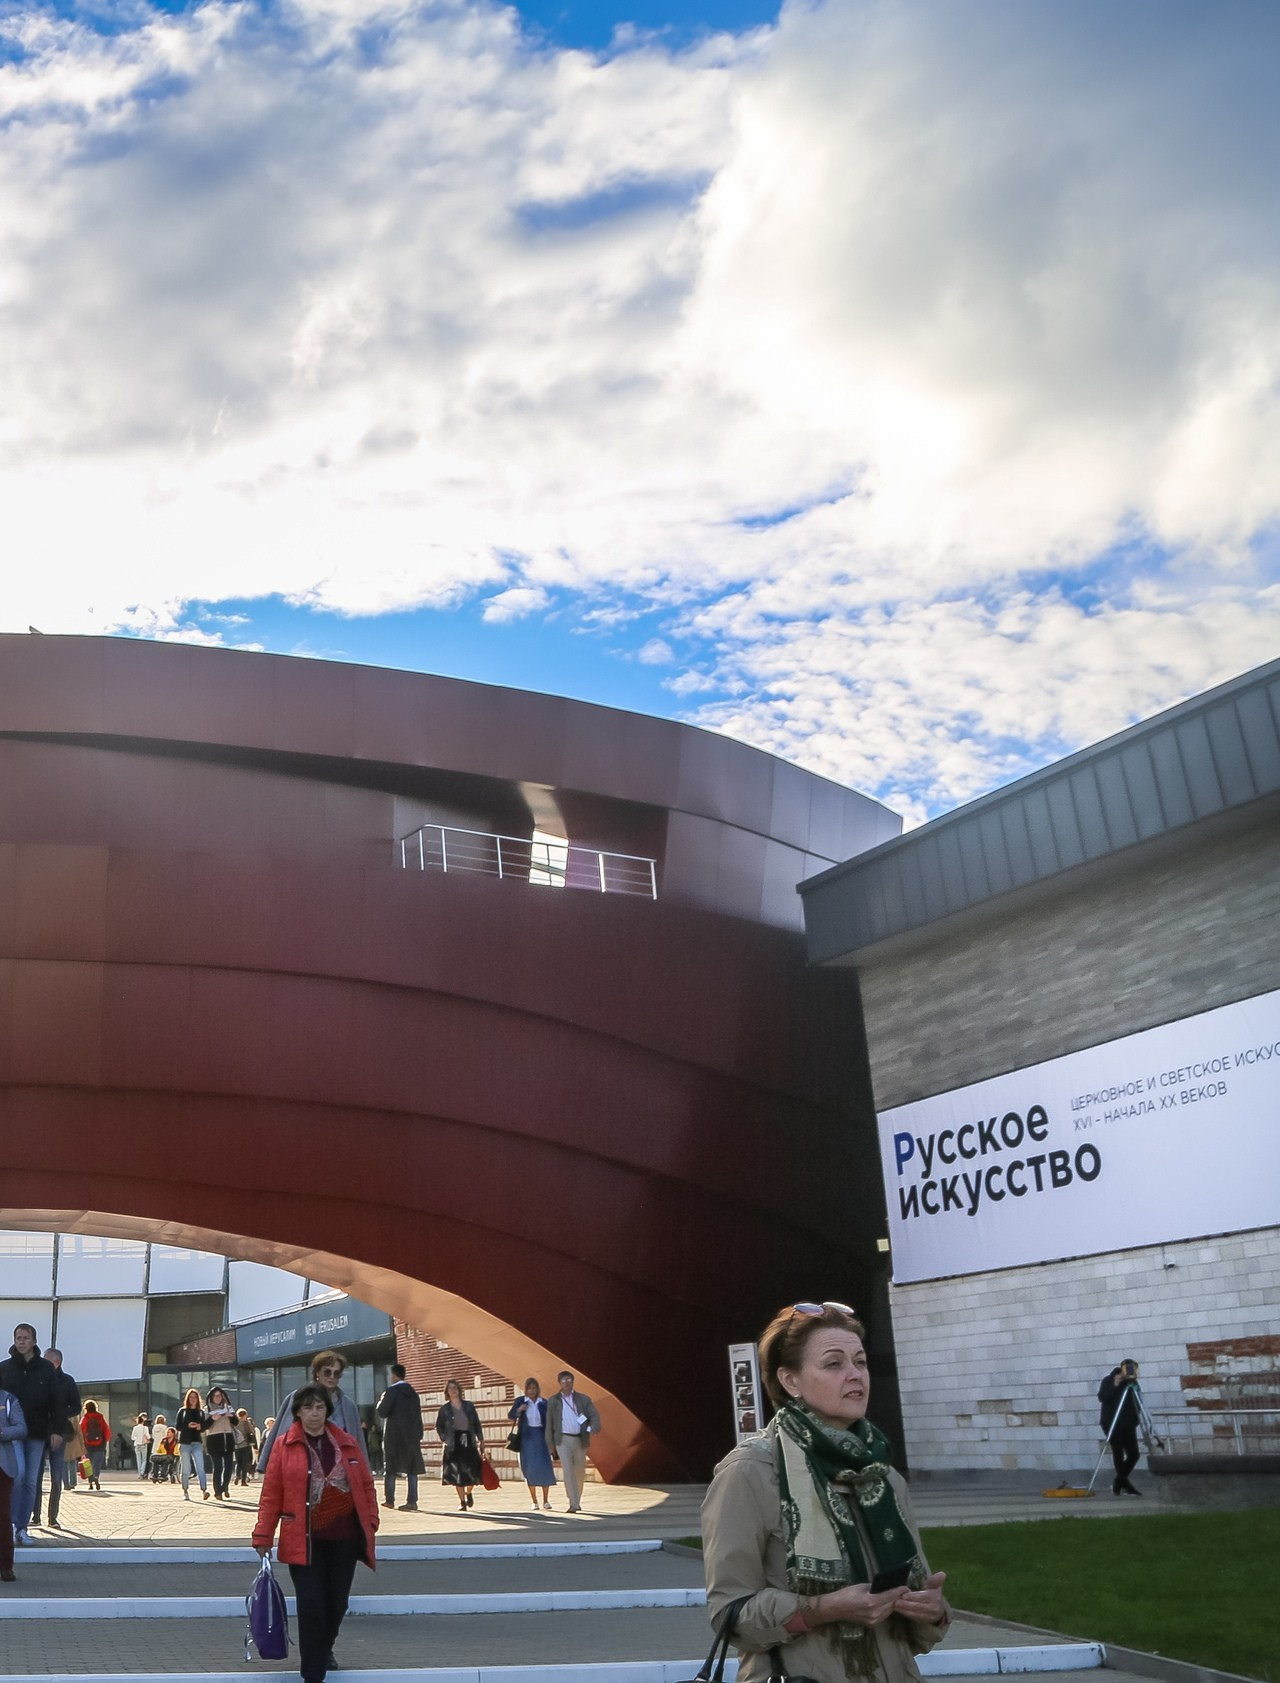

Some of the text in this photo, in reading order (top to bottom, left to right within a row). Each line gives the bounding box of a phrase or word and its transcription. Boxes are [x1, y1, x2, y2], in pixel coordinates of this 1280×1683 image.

[1070, 1079, 1144, 1112] ЦЕРКОВНОЕ
[1146, 1076, 1157, 1091] И
[1159, 1055, 1232, 1087] СВЕТСКОЕ
[1104, 1099, 1156, 1125] НАЧАЛА
[1180, 1080, 1228, 1105] ВЕКОВ
[893, 1104, 1050, 1179] Русское
[898, 1142, 1103, 1221] искусство
